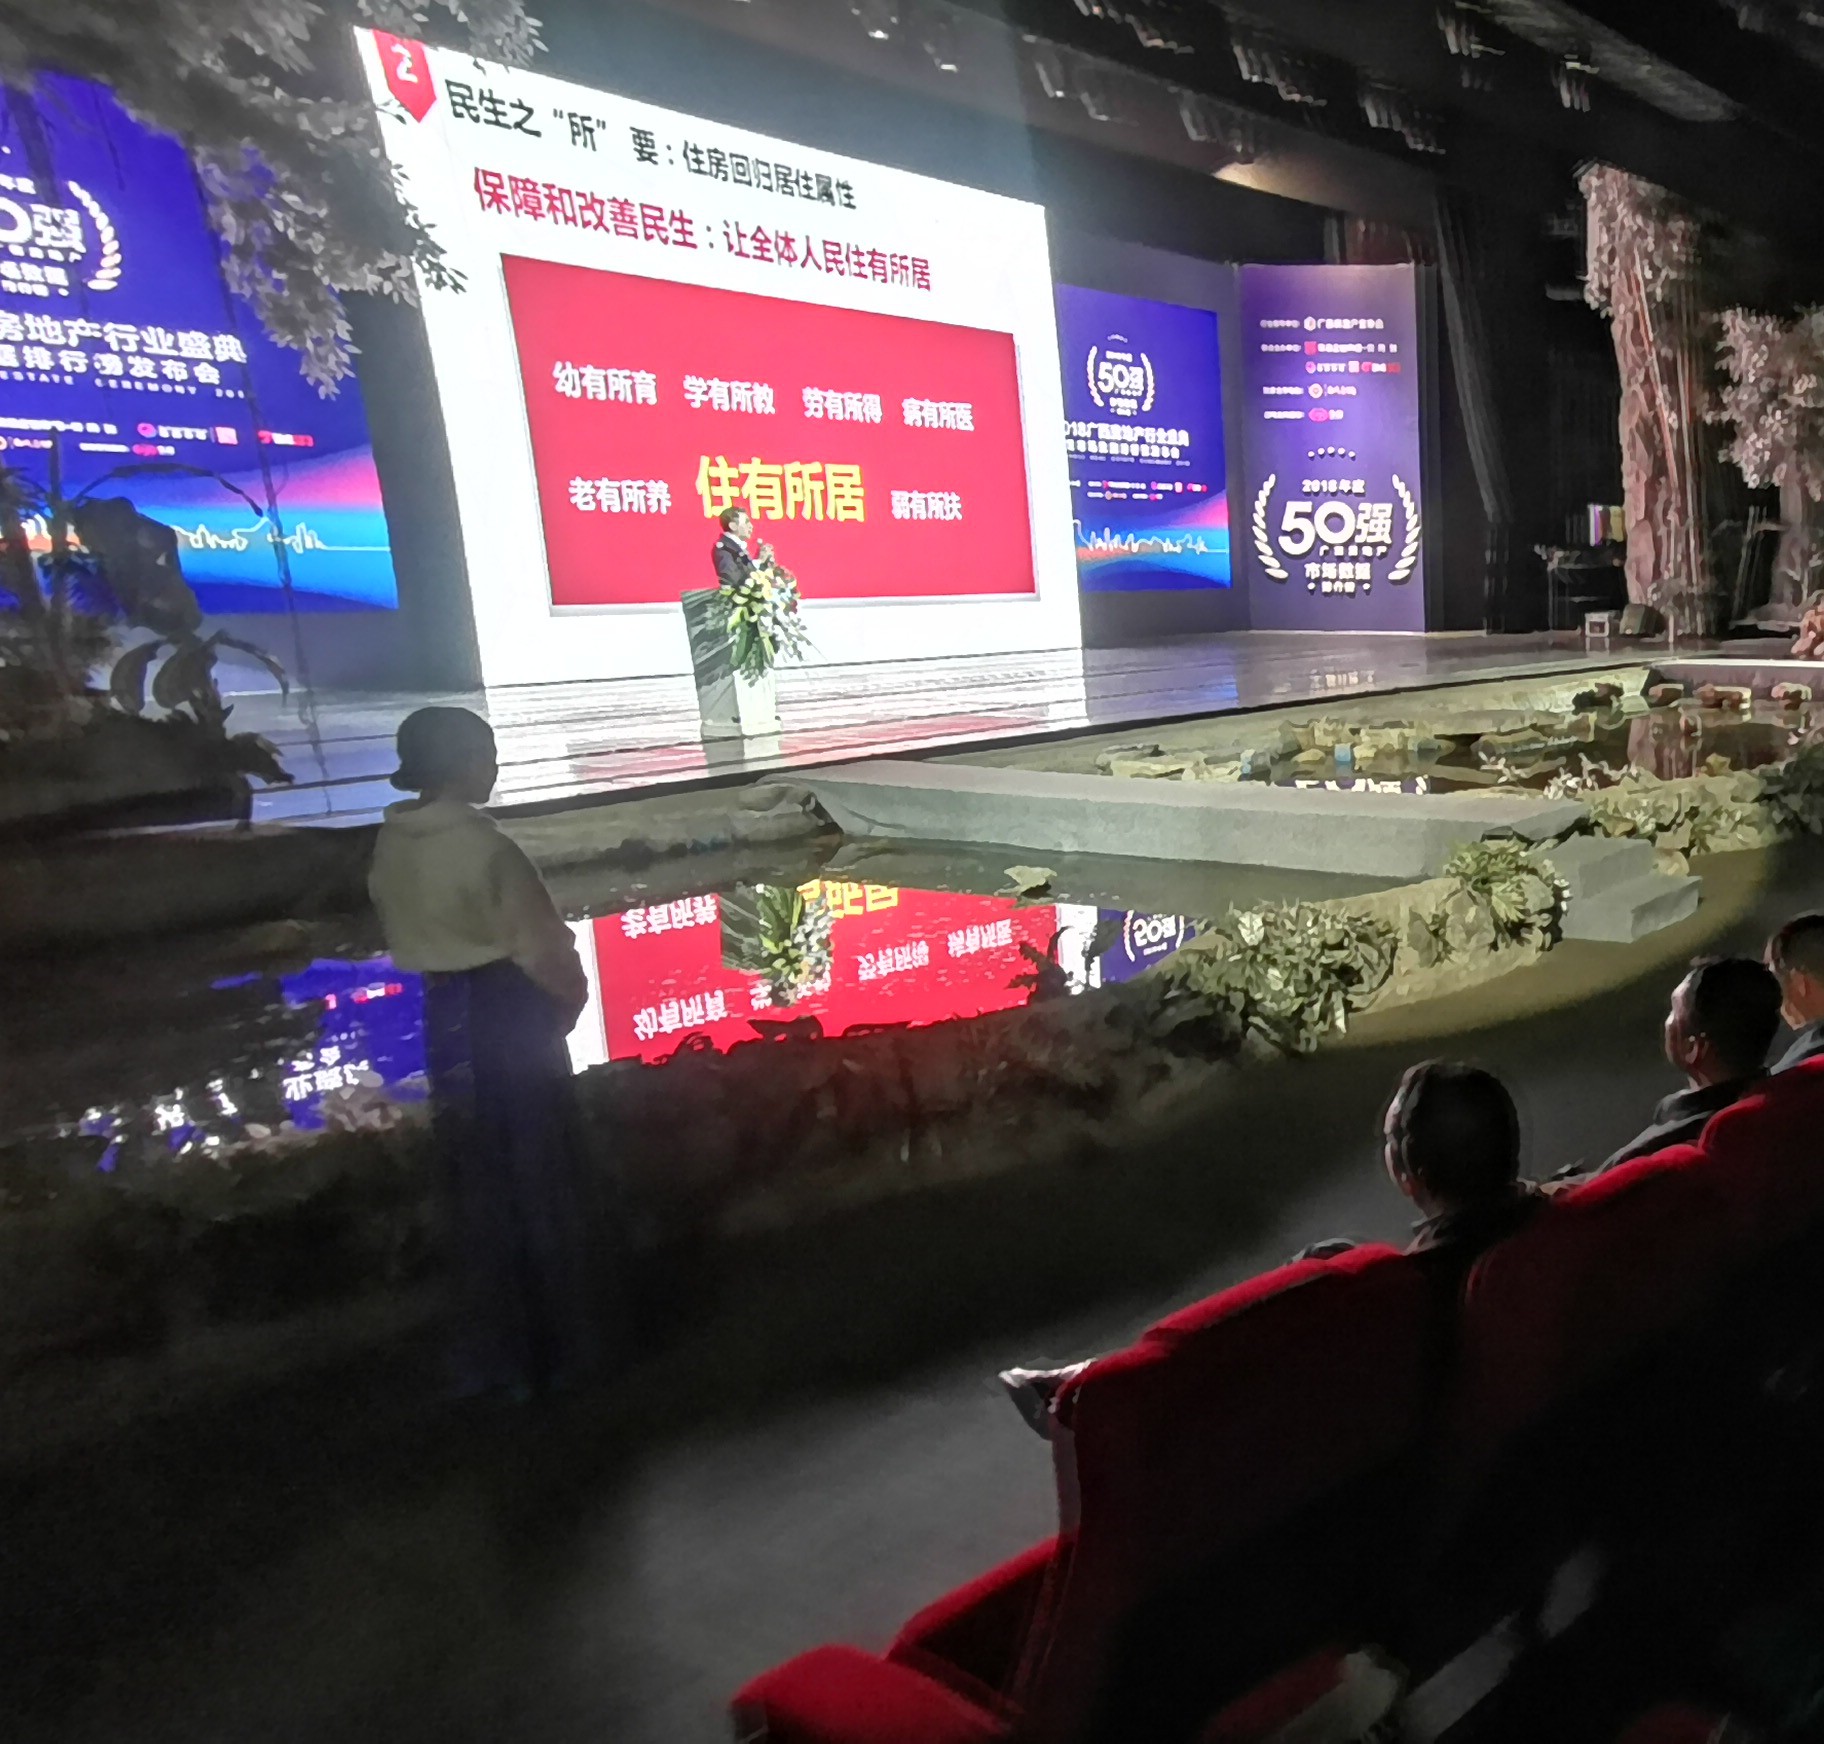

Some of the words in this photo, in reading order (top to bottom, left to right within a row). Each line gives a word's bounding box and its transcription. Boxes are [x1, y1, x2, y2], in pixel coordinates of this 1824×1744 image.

[391, 43, 418, 83] 2
[474, 167, 931, 291] 保障和改善民生：让全体人民住有所居
[553, 361, 657, 405] 幼有所育
[683, 375, 776, 414] 学有所教
[568, 477, 672, 514] 老有所养
[695, 455, 865, 522] 住有所居
[1278, 501, 1393, 556] 50强
